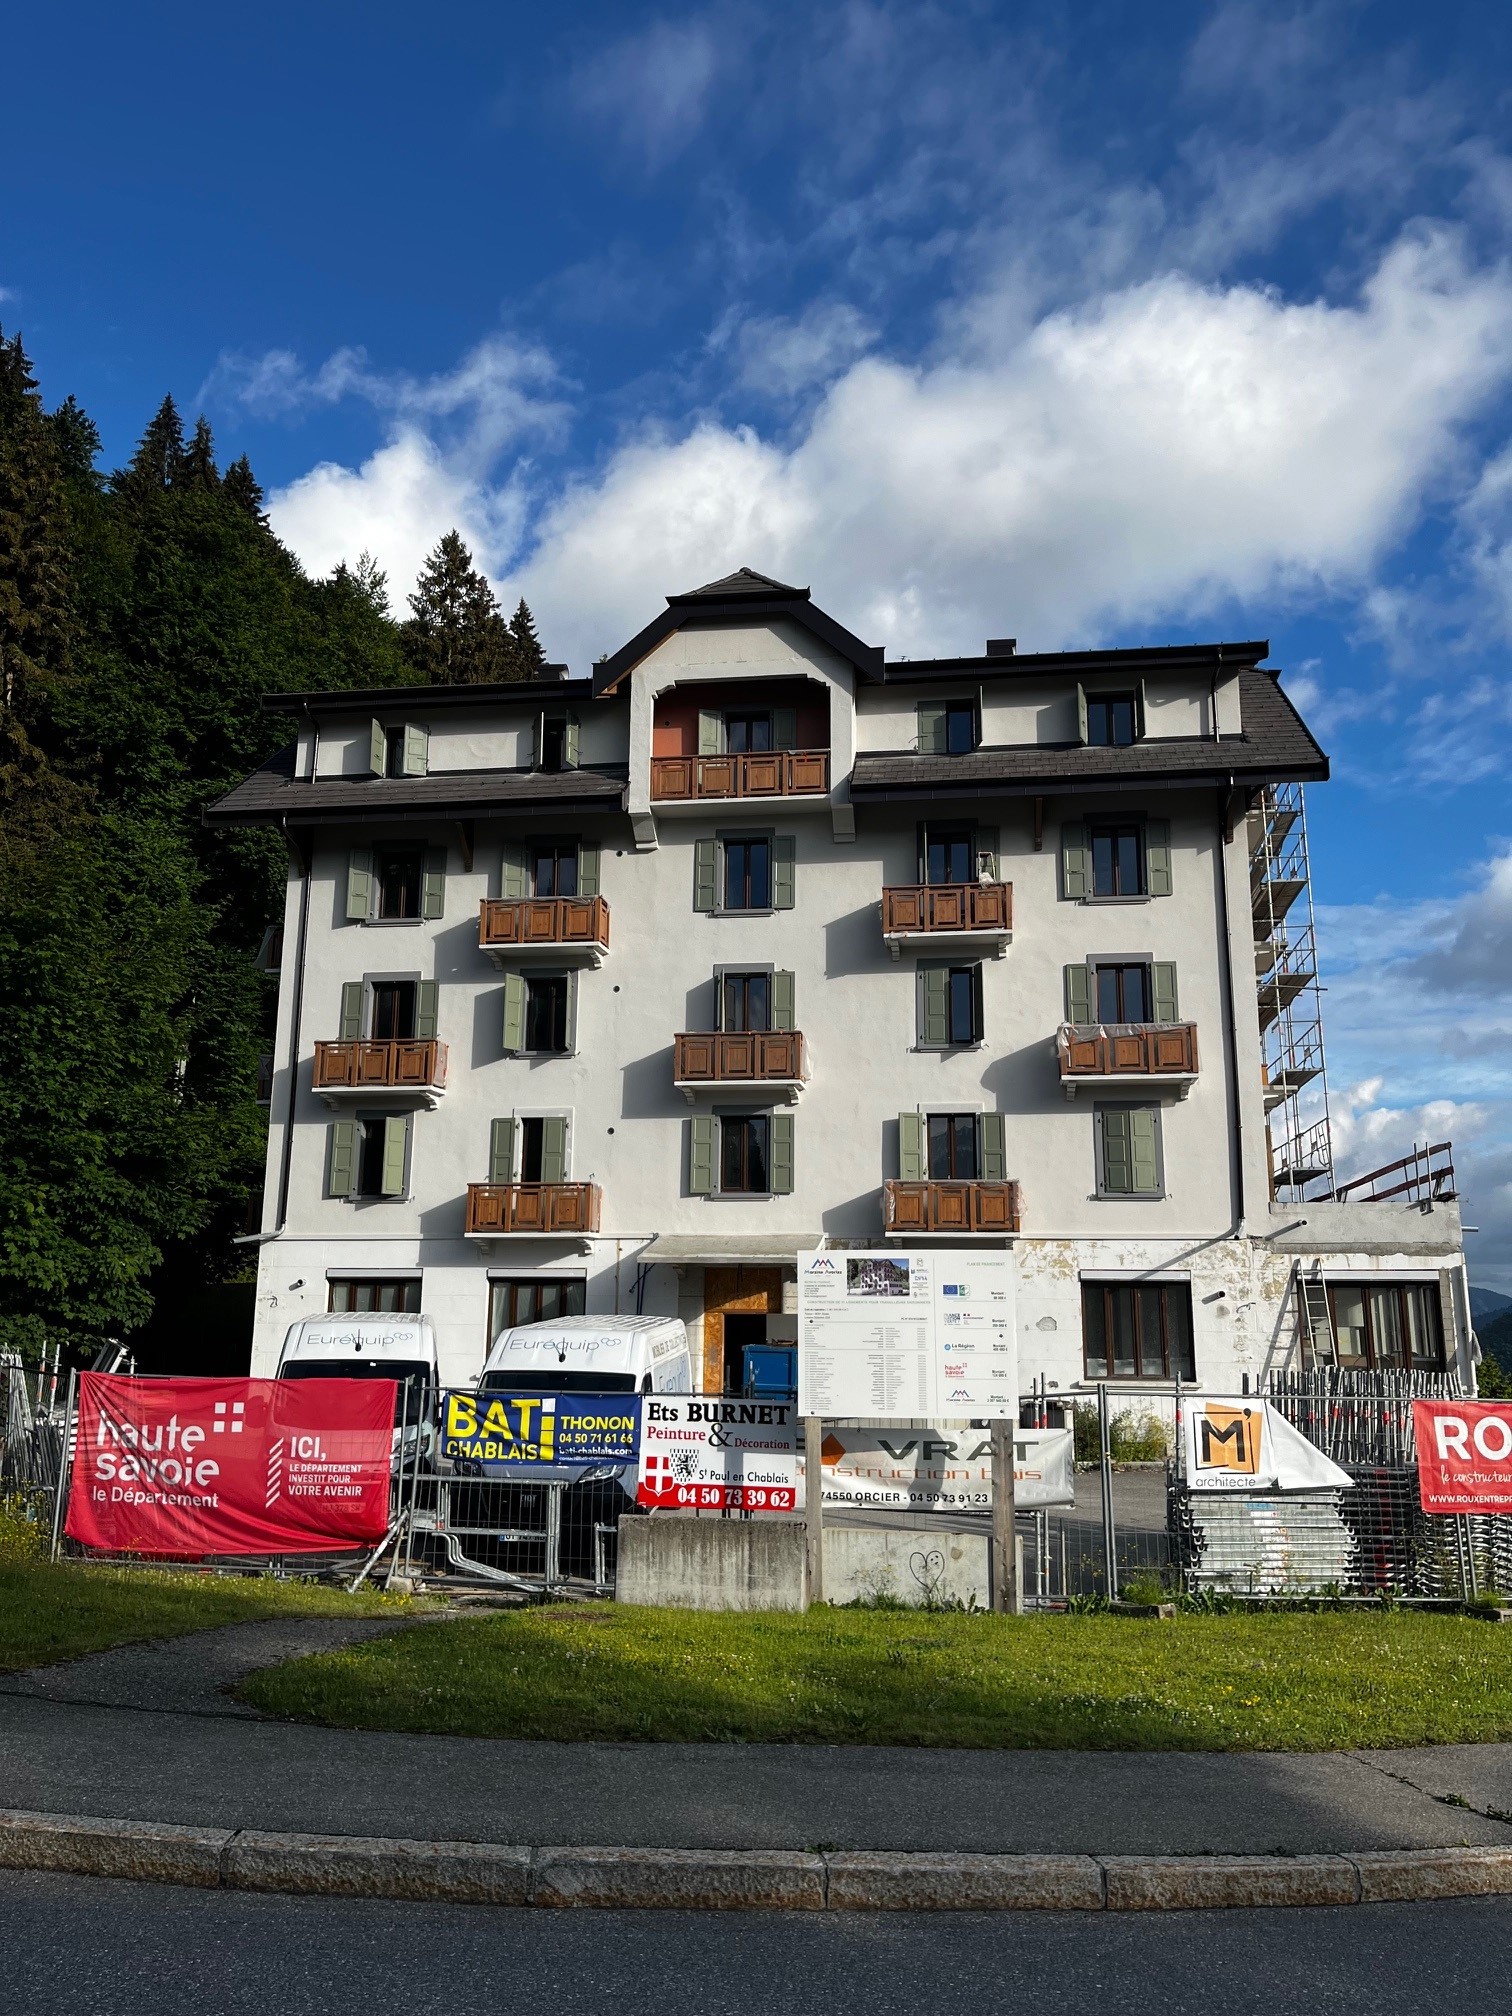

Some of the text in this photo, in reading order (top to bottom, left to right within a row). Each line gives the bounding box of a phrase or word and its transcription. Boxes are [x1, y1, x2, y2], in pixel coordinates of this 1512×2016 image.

[560, 1416, 635, 1431] THONON
[647, 1402, 790, 1426] Ets BURNET
[97, 1409, 206, 1453] haute
[559, 1433, 634, 1444] 04 50 71 61 66
[646, 1425, 706, 1441] Peinture
[708, 1422, 734, 1448] &
[1433, 1415, 1512, 1461] RO
[290, 1436, 327, 1462] ICI,
[446, 1440, 538, 1460] CHABLAIS
[734, 1437, 790, 1450] Décoration
[877, 1439, 1040, 1462] VRAT
[94, 1452, 220, 1487] savoie
[289, 1462, 363, 1473] LE DÉPARTEMENT
[709, 1470, 730, 1481] Paul
[732, 1473, 745, 1482] en
[746, 1471, 789, 1484] Chablais
[1440, 1464, 1451, 1485] le
[288, 1474, 351, 1483] INVESTIT POUR
[1195, 1476, 1256, 1487] architecte
[92, 1484, 219, 1508] le Département
[288, 1485, 363, 1496] VOTRE AVENIR
[677, 1487, 790, 1507] 04 50 73 39 62
[855, 1491, 900, 1502] ORCIER
[911, 1493, 924, 1502] 04
[926, 1493, 940, 1502] 50
[942, 1494, 956, 1503] 73
[958, 1494, 971, 1503] 91
[974, 1493, 988, 1503] 23
